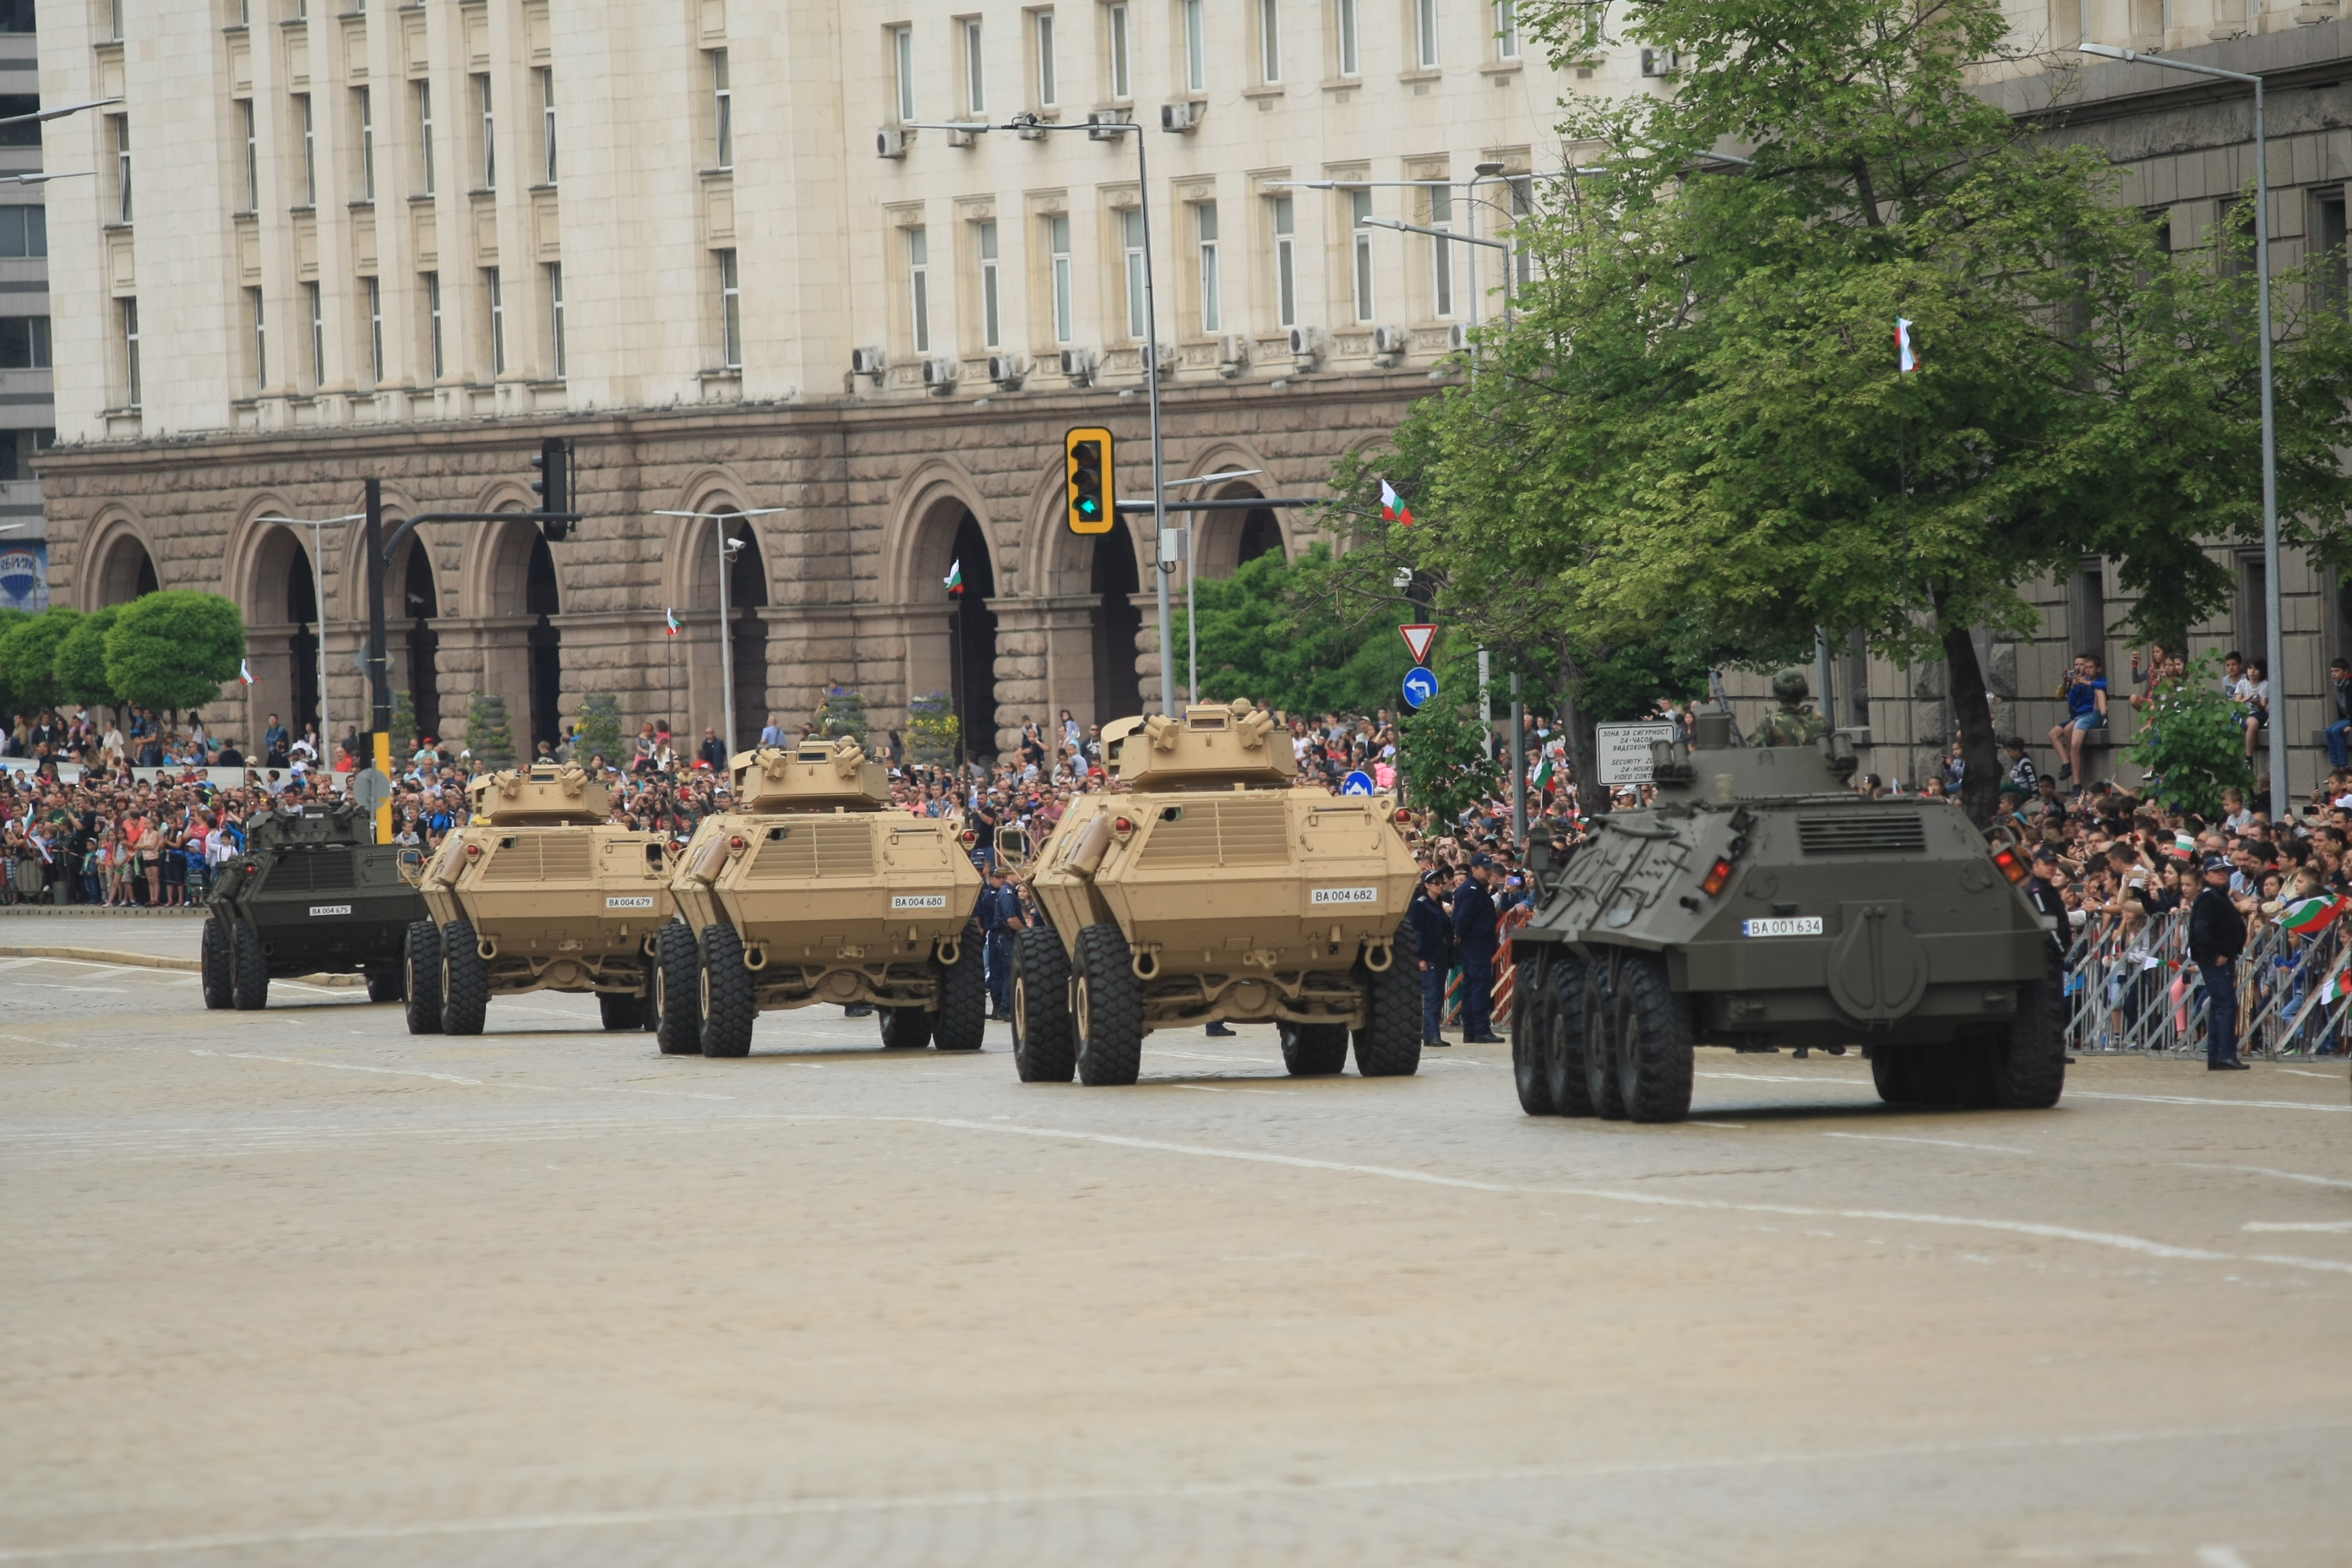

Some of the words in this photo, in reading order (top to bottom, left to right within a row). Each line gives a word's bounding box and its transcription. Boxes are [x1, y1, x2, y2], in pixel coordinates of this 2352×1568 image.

[1316, 892, 1329, 901] BA
[1332, 890, 1350, 900] 004
[1354, 889, 1372, 900] 682
[895, 898, 906, 906] BA
[908, 898, 924, 906] 004
[926, 898, 942, 906] 680
[1752, 921, 1769, 934] BA
[1772, 919, 1820, 933] 001634
